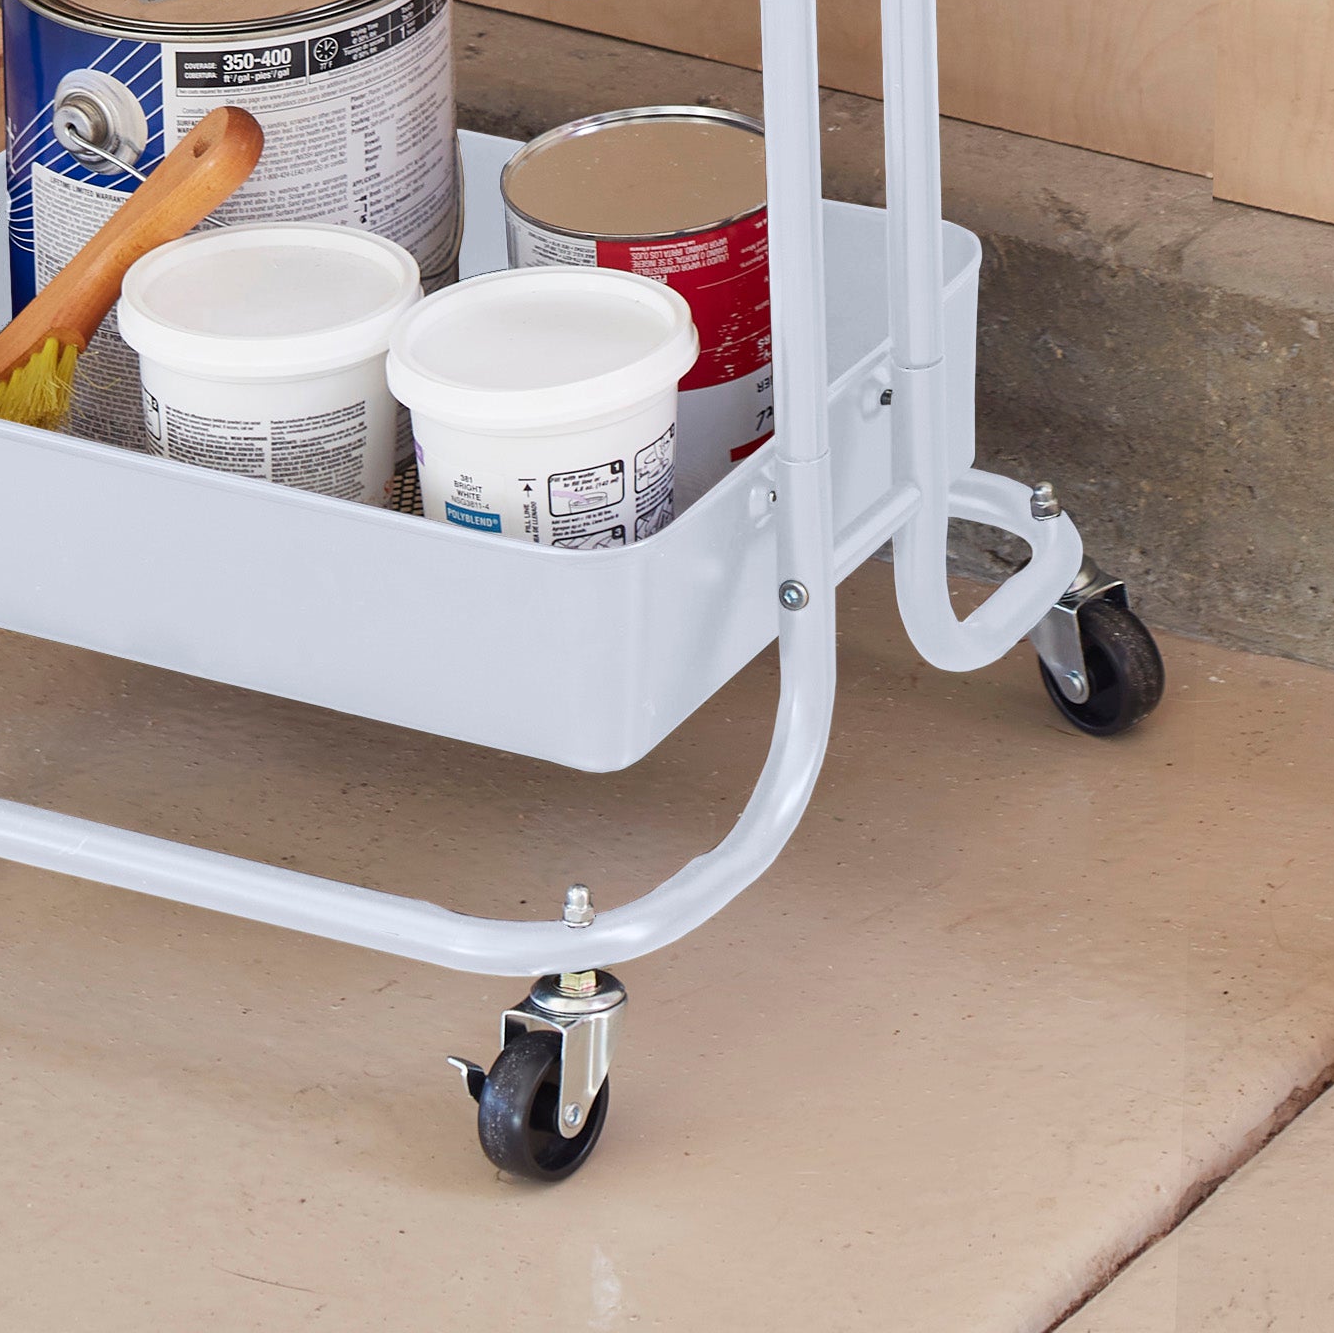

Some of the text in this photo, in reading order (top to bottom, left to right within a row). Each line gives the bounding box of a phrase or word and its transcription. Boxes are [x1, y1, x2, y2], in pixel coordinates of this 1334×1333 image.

[223, 47, 292, 72] 350-400
[184, 62, 218, 70] COVERAGE:
[650, 250, 663, 259] LOS
[459, 474, 473, 484] 381
[453, 480, 483, 493] BRIGHT
[456, 489, 481, 502] WHITE
